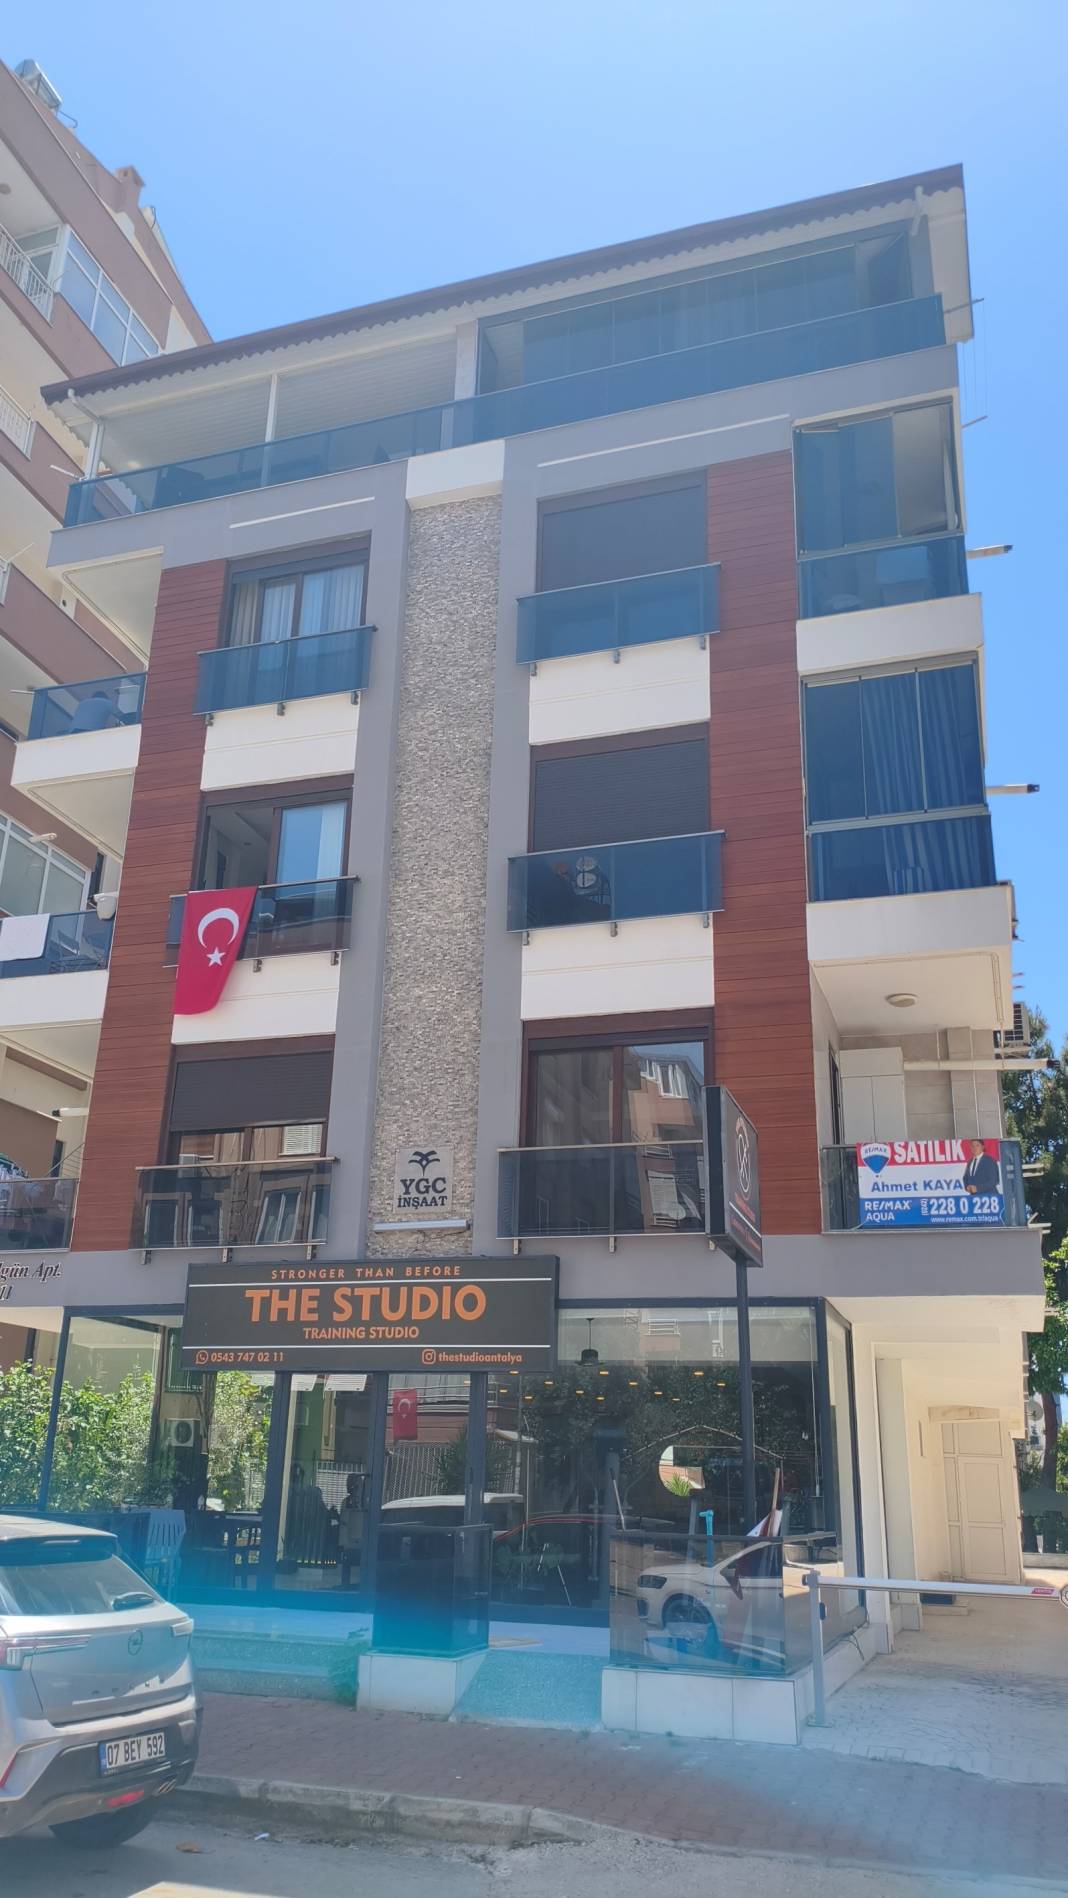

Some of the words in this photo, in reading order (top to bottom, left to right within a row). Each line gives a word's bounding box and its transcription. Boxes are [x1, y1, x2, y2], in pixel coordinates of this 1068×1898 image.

[894, 1139, 965, 1163] SATILIK
[400, 1178, 446, 1195] YGC
[871, 1182, 918, 1192] Ahmet
[923, 1179, 963, 1191] KAYA
[397, 1195, 448, 1210] İNŞAAT
[864, 1200, 911, 1211] RE/MAX
[930, 1198, 956, 1215] 228
[960, 1197, 968, 1214] 0
[973, 1197, 999, 1213] 228
[866, 1212, 895, 1222] AQUA
[33, 1262, 61, 1282] Apt.
[271, 1269, 345, 1280] STRONGER
[356, 1267, 394, 1278] THAN
[405, 1266, 461, 1277] BEFORE
[245, 1288, 320, 1322] THE
[333, 1284, 487, 1322] STUDIO
[303, 1327, 366, 1340] TRAINING
[369, 1326, 420, 1339] STUDIO
[211, 1352, 234, 1362] 0543
[237, 1352, 254, 1362] 747
[257, 1352, 269, 1362] 02
[273, 1352, 284, 1362] 11
[438, 1352, 523, 1364] thestudioantalya
[107, 1743, 120, 1766] 07
[124, 1739, 142, 1762] BEY
[146, 1734, 164, 1756] 592
